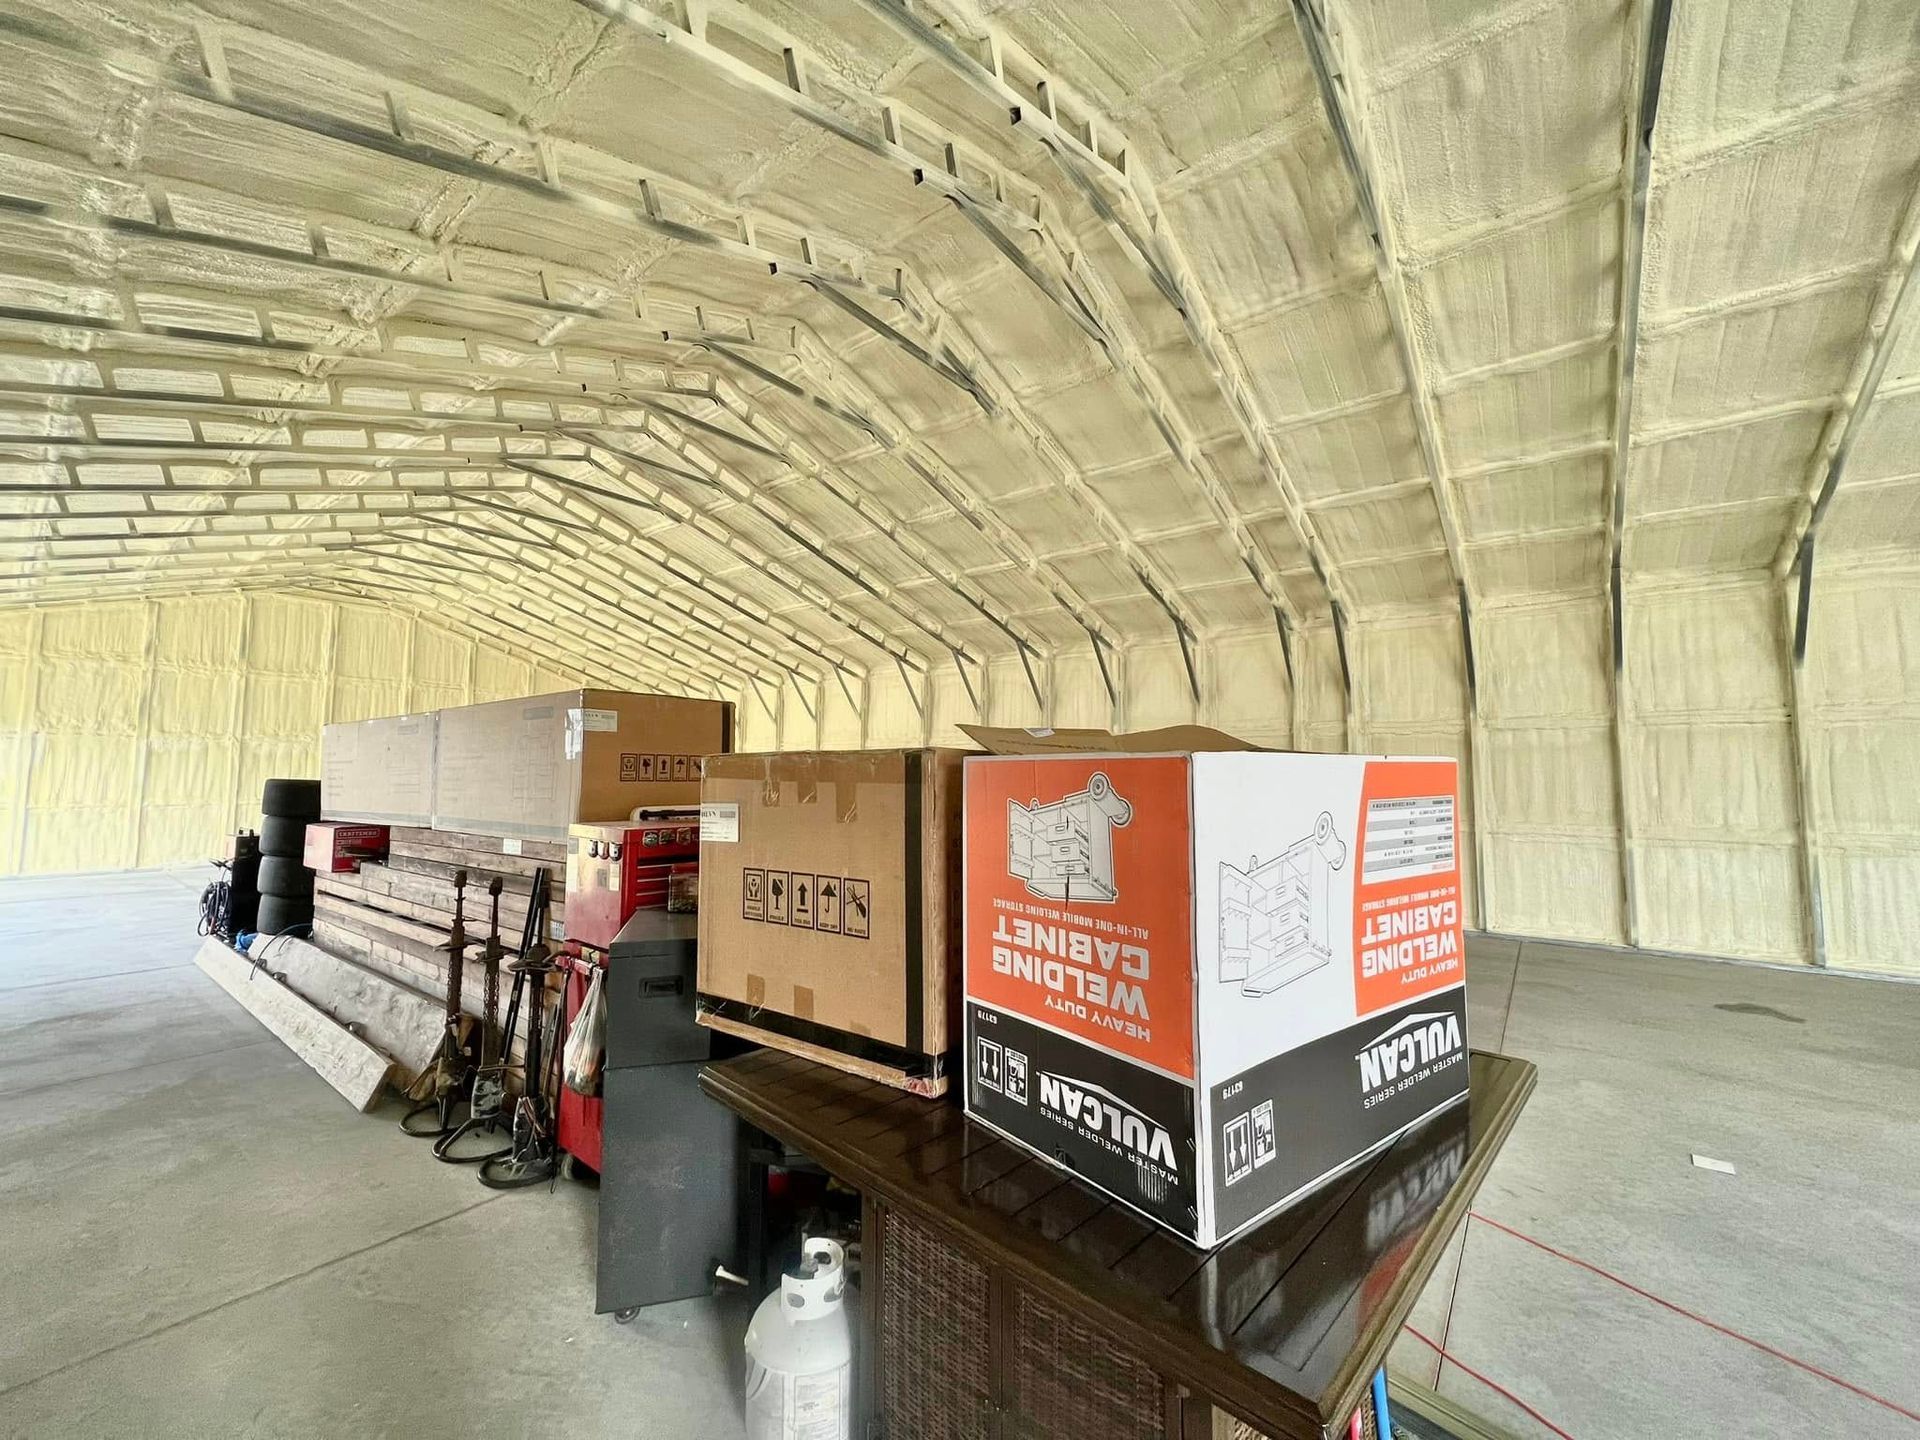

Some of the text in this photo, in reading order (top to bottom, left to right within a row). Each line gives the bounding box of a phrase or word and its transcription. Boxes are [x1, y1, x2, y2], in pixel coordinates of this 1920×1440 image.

[993, 897, 1149, 940] ALL-IN-ONE MOBILE WELDING STORAGE
[1361, 901, 1456, 945] CABINET
[992, 915, 1150, 980] CABINET
[1362, 930, 1457, 978] WELDING
[1402, 957, 1458, 984] HEAVY DUTY
[992, 945, 1150, 1020] WELDING
[1044, 995, 1150, 1043] HEAVY DUTY
[1360, 1014, 1462, 1093] VULCAN
[1363, 1052, 1463, 1109] MASTER WELDER SERIES
[1040, 1073, 1178, 1171] VULCAN
[1040, 1106, 1179, 1185] MASTER WELDER SERIES
